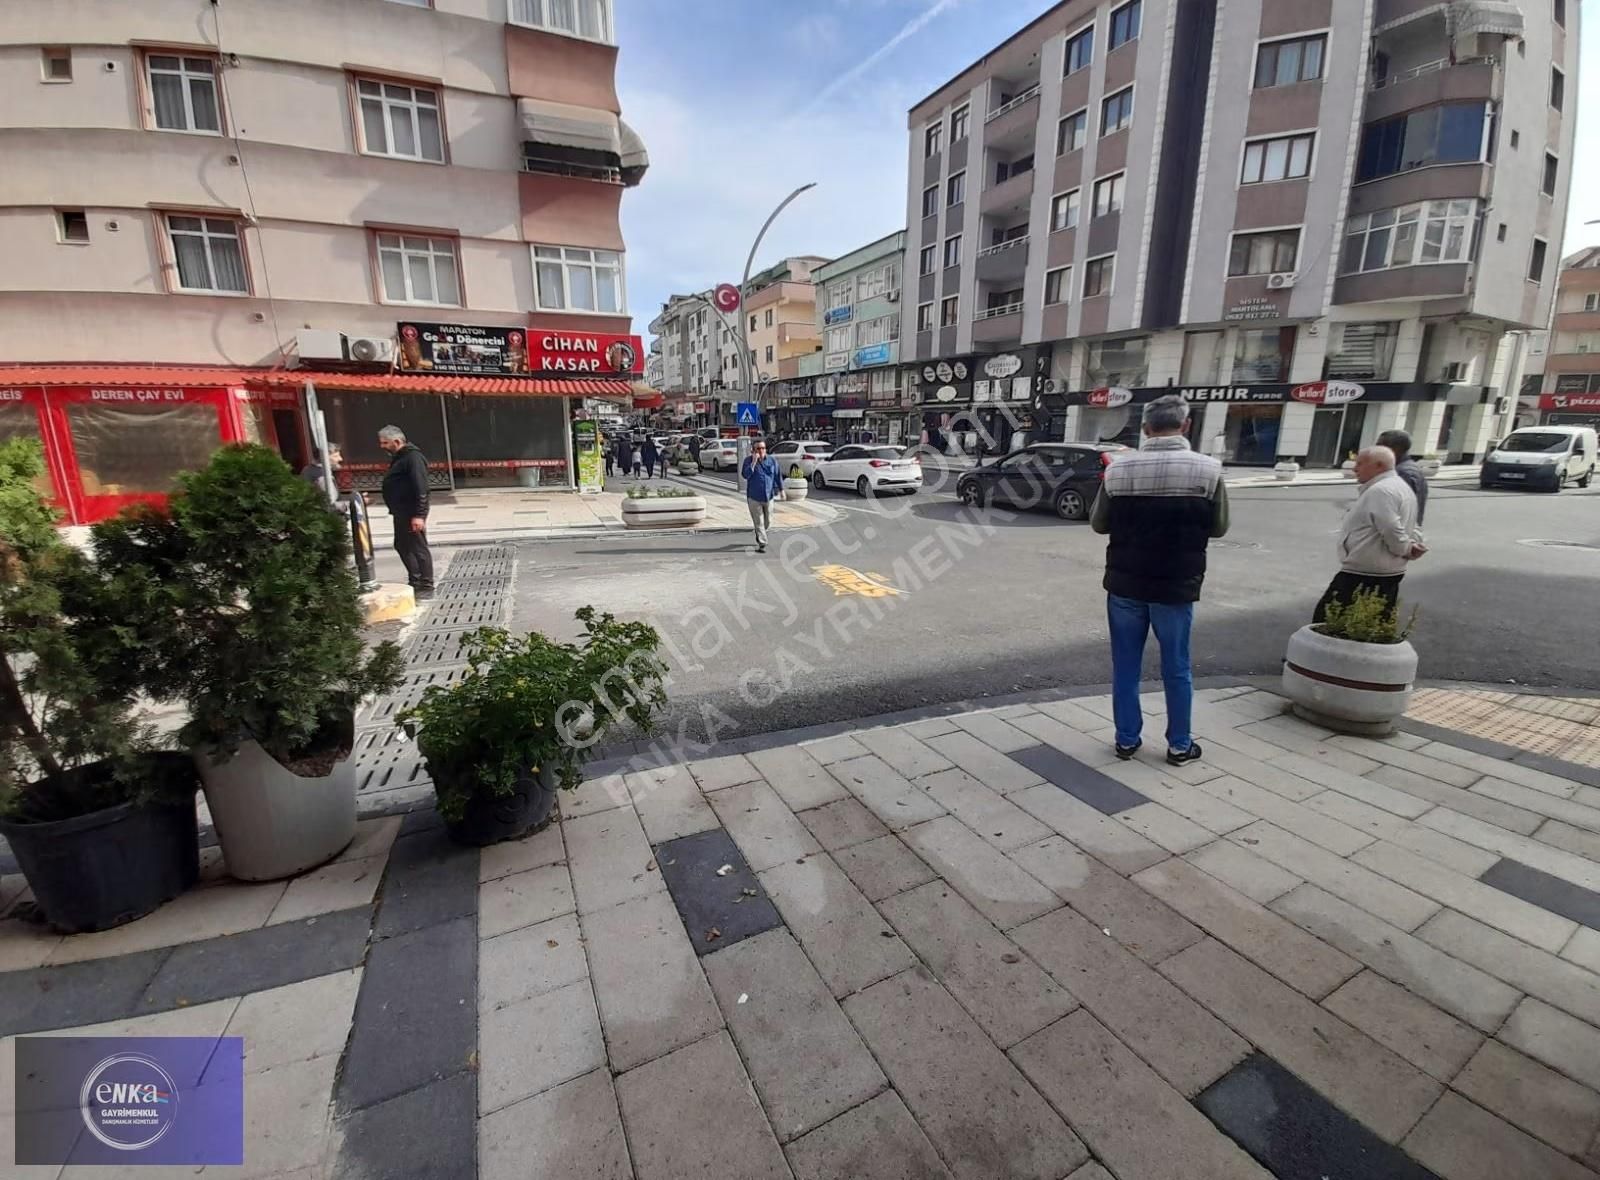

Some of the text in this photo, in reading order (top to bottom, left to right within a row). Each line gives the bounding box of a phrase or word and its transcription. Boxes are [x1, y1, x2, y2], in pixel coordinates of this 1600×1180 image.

[440, 325, 486, 336] MARATON
[542, 333, 598, 353] CİHAN
[541, 356, 600, 371] KASAP
[0, 388, 23, 400] EİS
[91, 388, 185, 402] DEREN ÇAY EVİ
[1181, 385, 1249, 400] NEHİR
[1328, 386, 1357, 398] store
